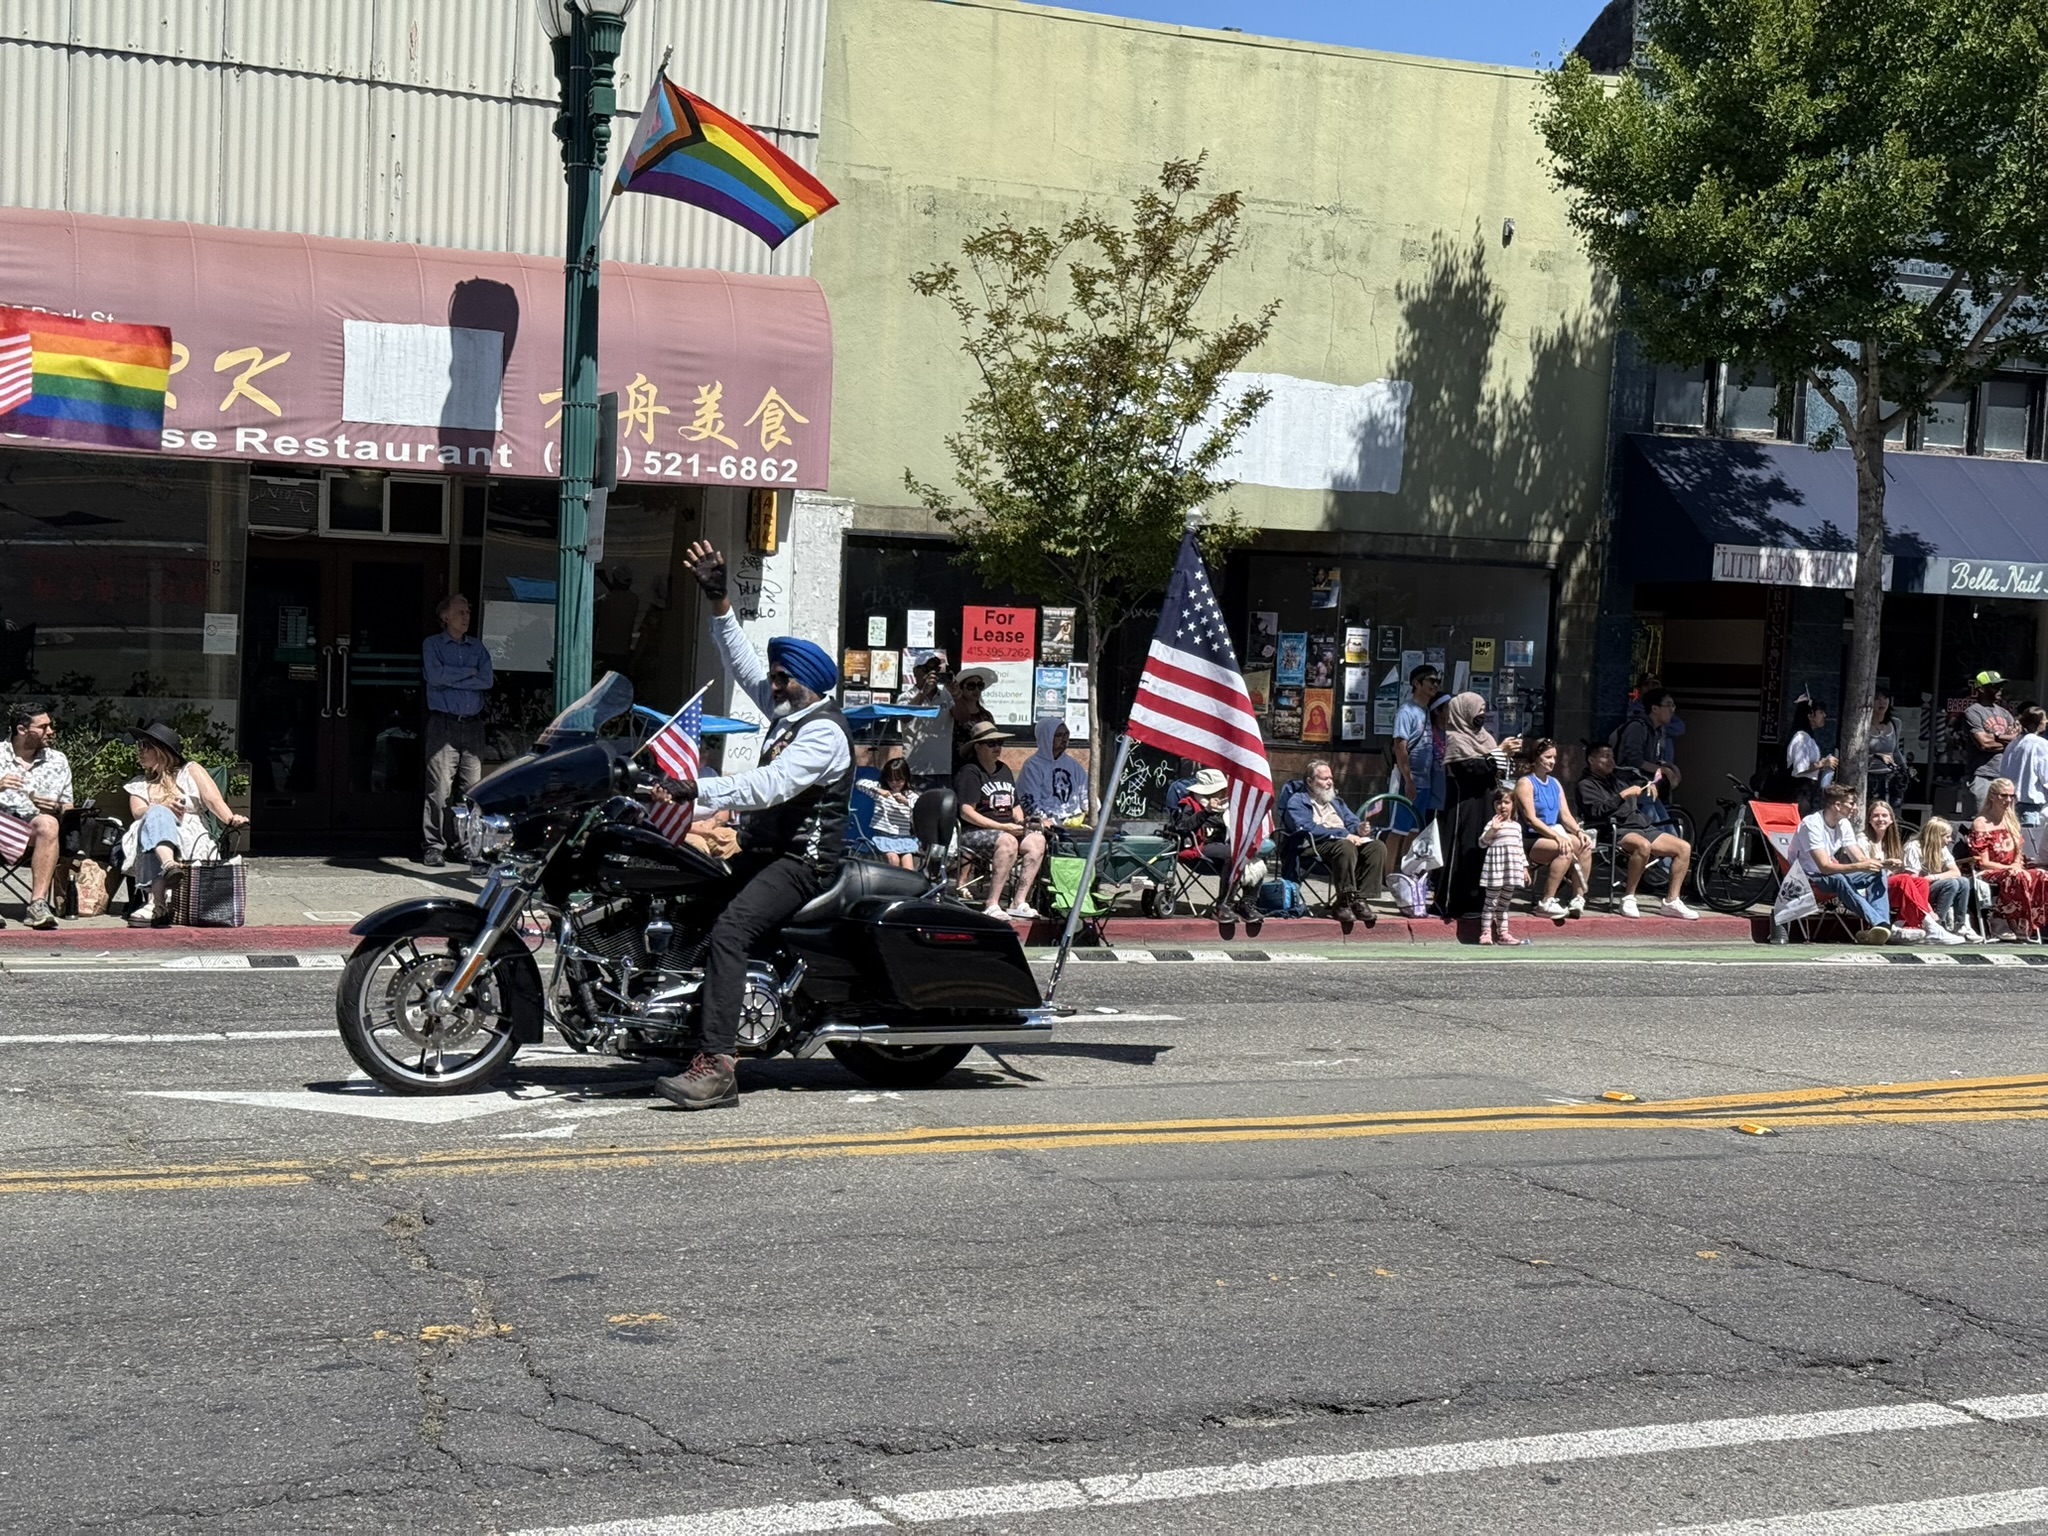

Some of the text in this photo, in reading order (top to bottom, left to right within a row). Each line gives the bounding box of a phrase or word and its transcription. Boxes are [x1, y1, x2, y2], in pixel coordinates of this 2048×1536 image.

[538, 372, 810, 453] 舟美食
[235, 428, 513, 468] Restaurant
[643, 451, 799, 483] 521-6862
[1720, 551, 1774, 581] LITTLE
[1951, 562, 2043, 593] Bella Nail
[985, 609, 1015, 625] For
[1770, 585, 1783, 648] RTUNE
[973, 626, 1025, 643] Lease
